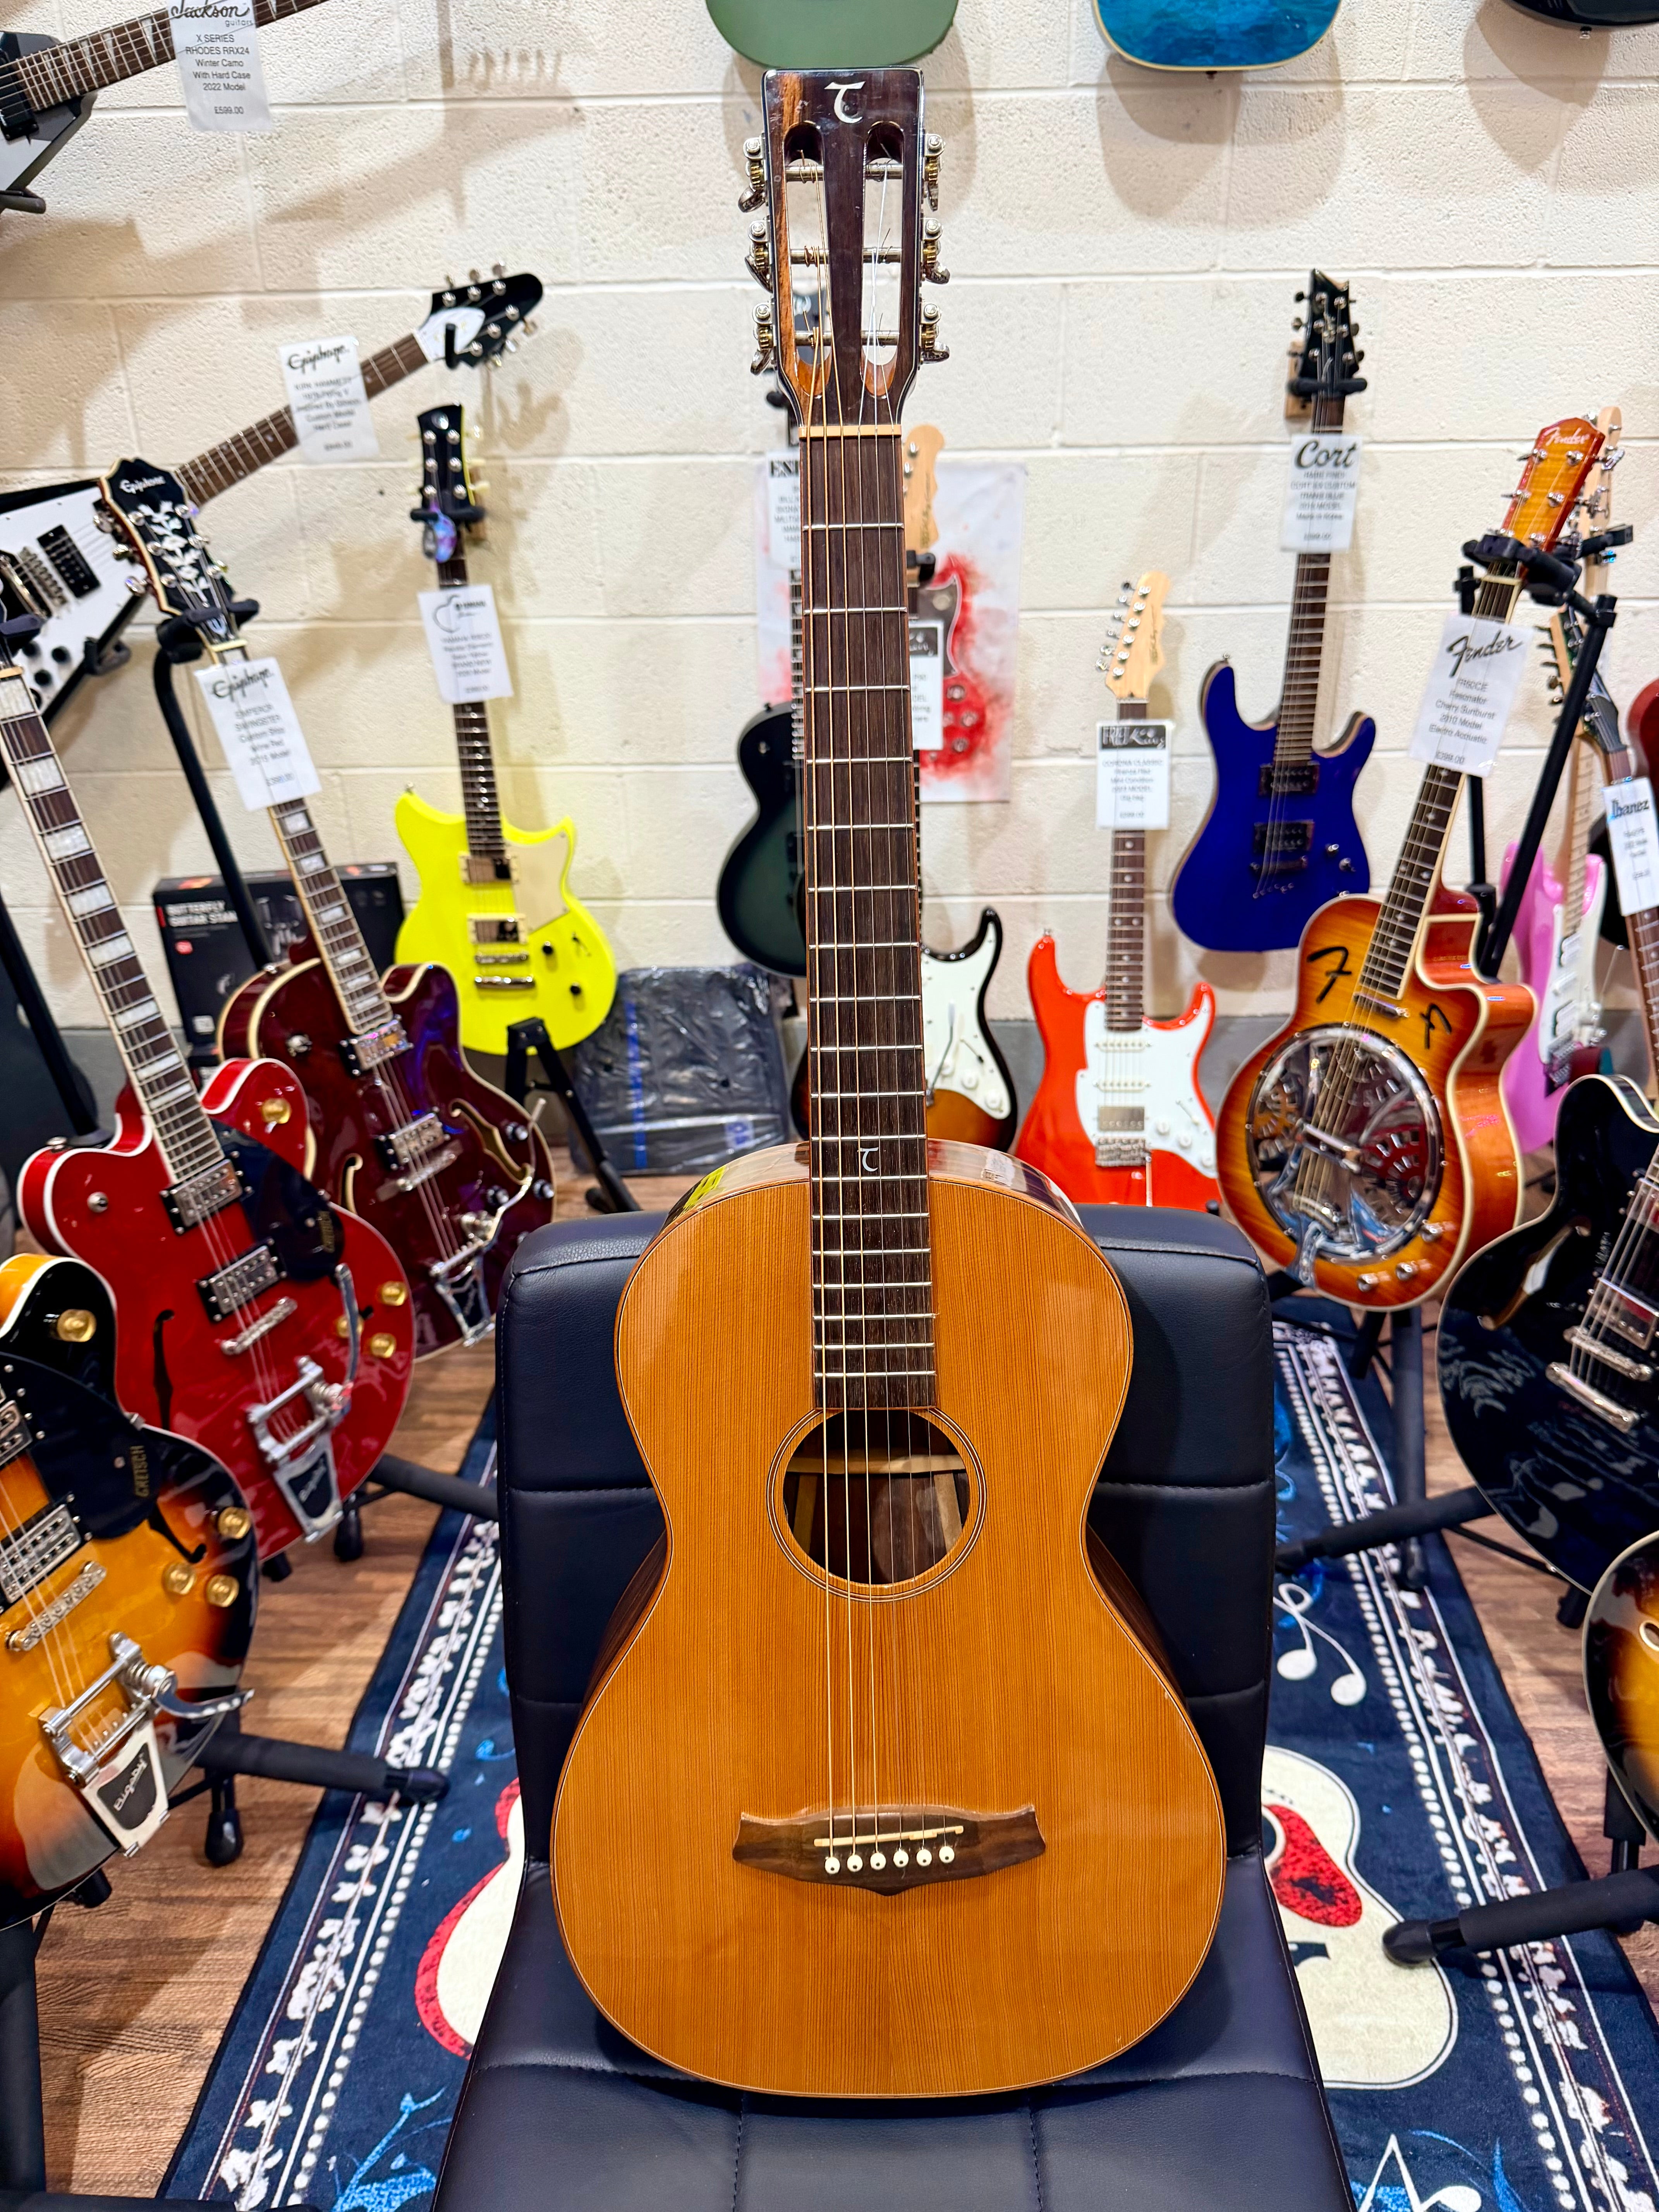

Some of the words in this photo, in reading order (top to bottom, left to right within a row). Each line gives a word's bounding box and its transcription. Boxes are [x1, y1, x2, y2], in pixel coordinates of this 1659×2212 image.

[171, 0, 250, 18] Jackson
[1544, 427, 1590, 446] Fender
[1295, 440, 1356, 469] Cort
[119, 476, 166, 494] Epiphone
[1446, 629, 1523, 677] Fender
[213, 668, 271, 702] Epiphone
[1449, 690, 1488, 704] Resonator
[1436, 699, 1459, 713] Cherry
[1460, 704, 1495, 720] Sunburst
[1458, 718, 1482, 730] Model
[1611, 798, 1650, 818] Ibanez
[208, 910, 239, 924] STAN
[130, 1445, 150, 1498] GRETSCH
[113, 1752, 148, 1812] Bigsby
